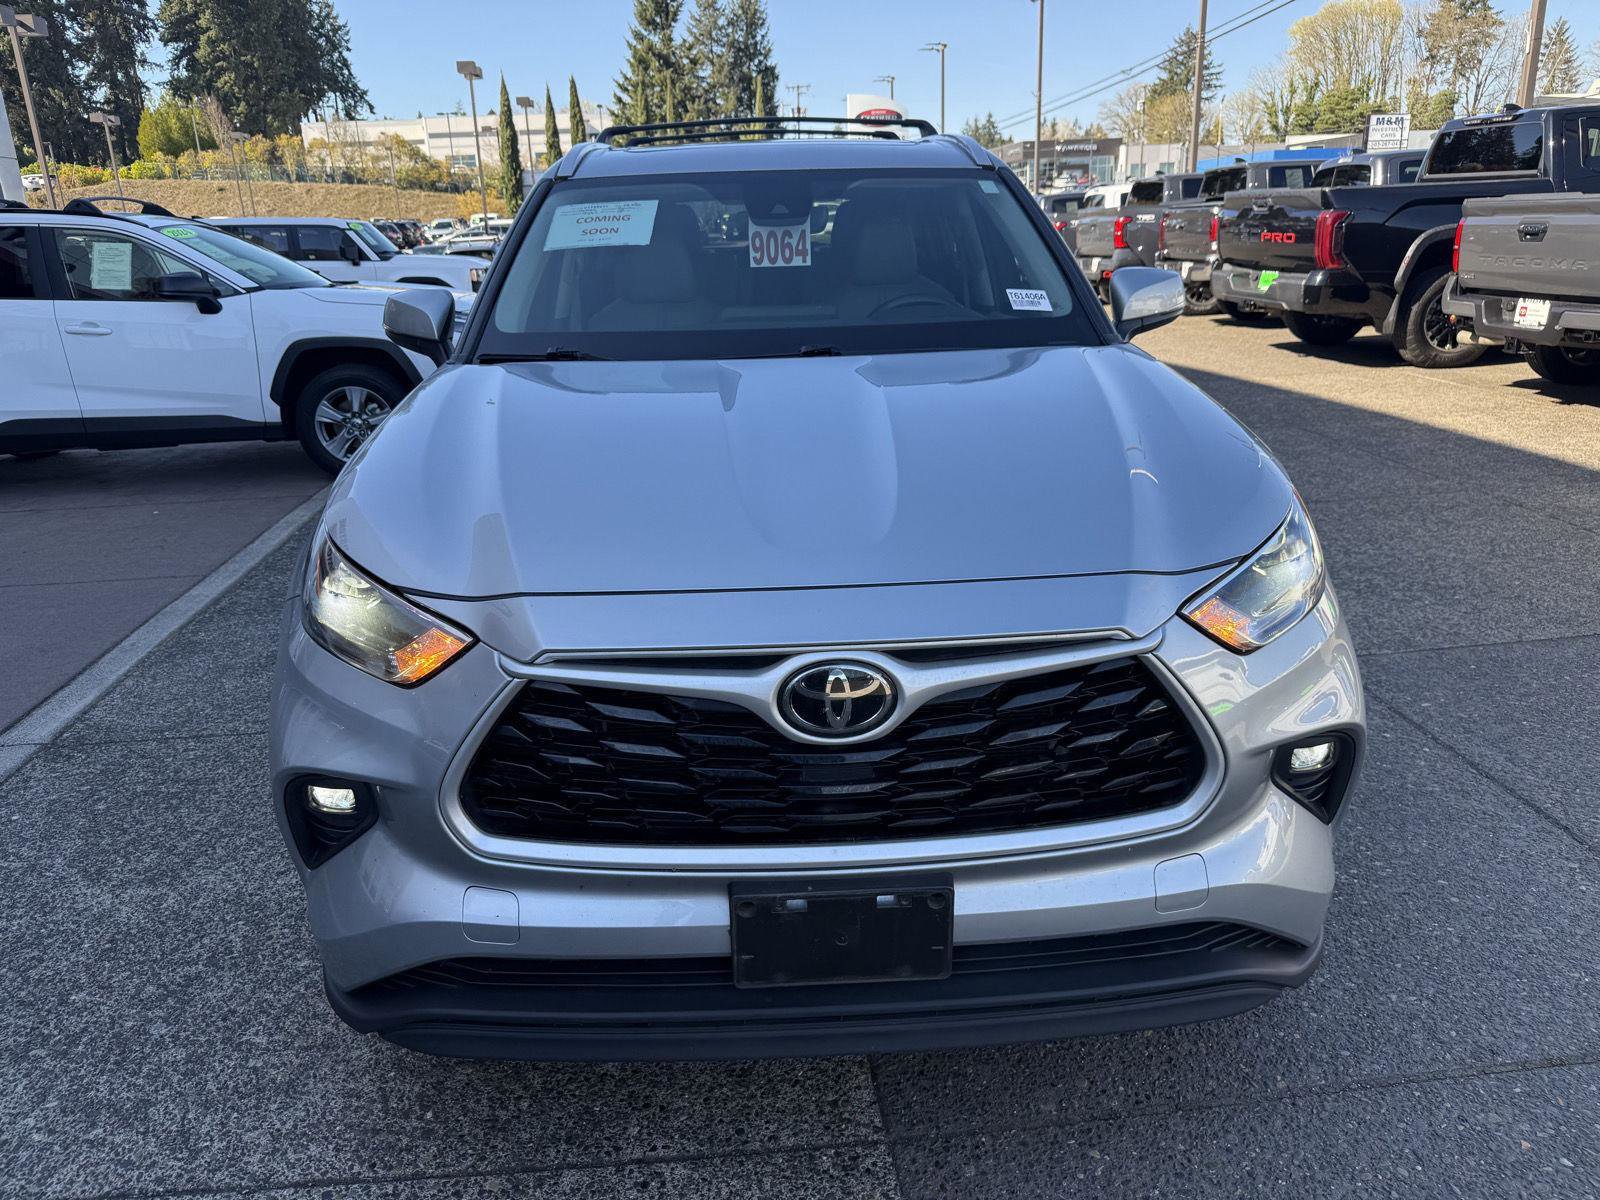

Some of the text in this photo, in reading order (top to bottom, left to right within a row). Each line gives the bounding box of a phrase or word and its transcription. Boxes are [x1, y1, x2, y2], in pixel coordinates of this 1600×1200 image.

[1376, 117, 1404, 126] M&M
[576, 214, 632, 225] COMING
[581, 227, 620, 236] SOON
[1260, 232, 1296, 243] PRO
[751, 229, 809, 266] 9064
[1478, 255, 1588, 271] TACOMA
